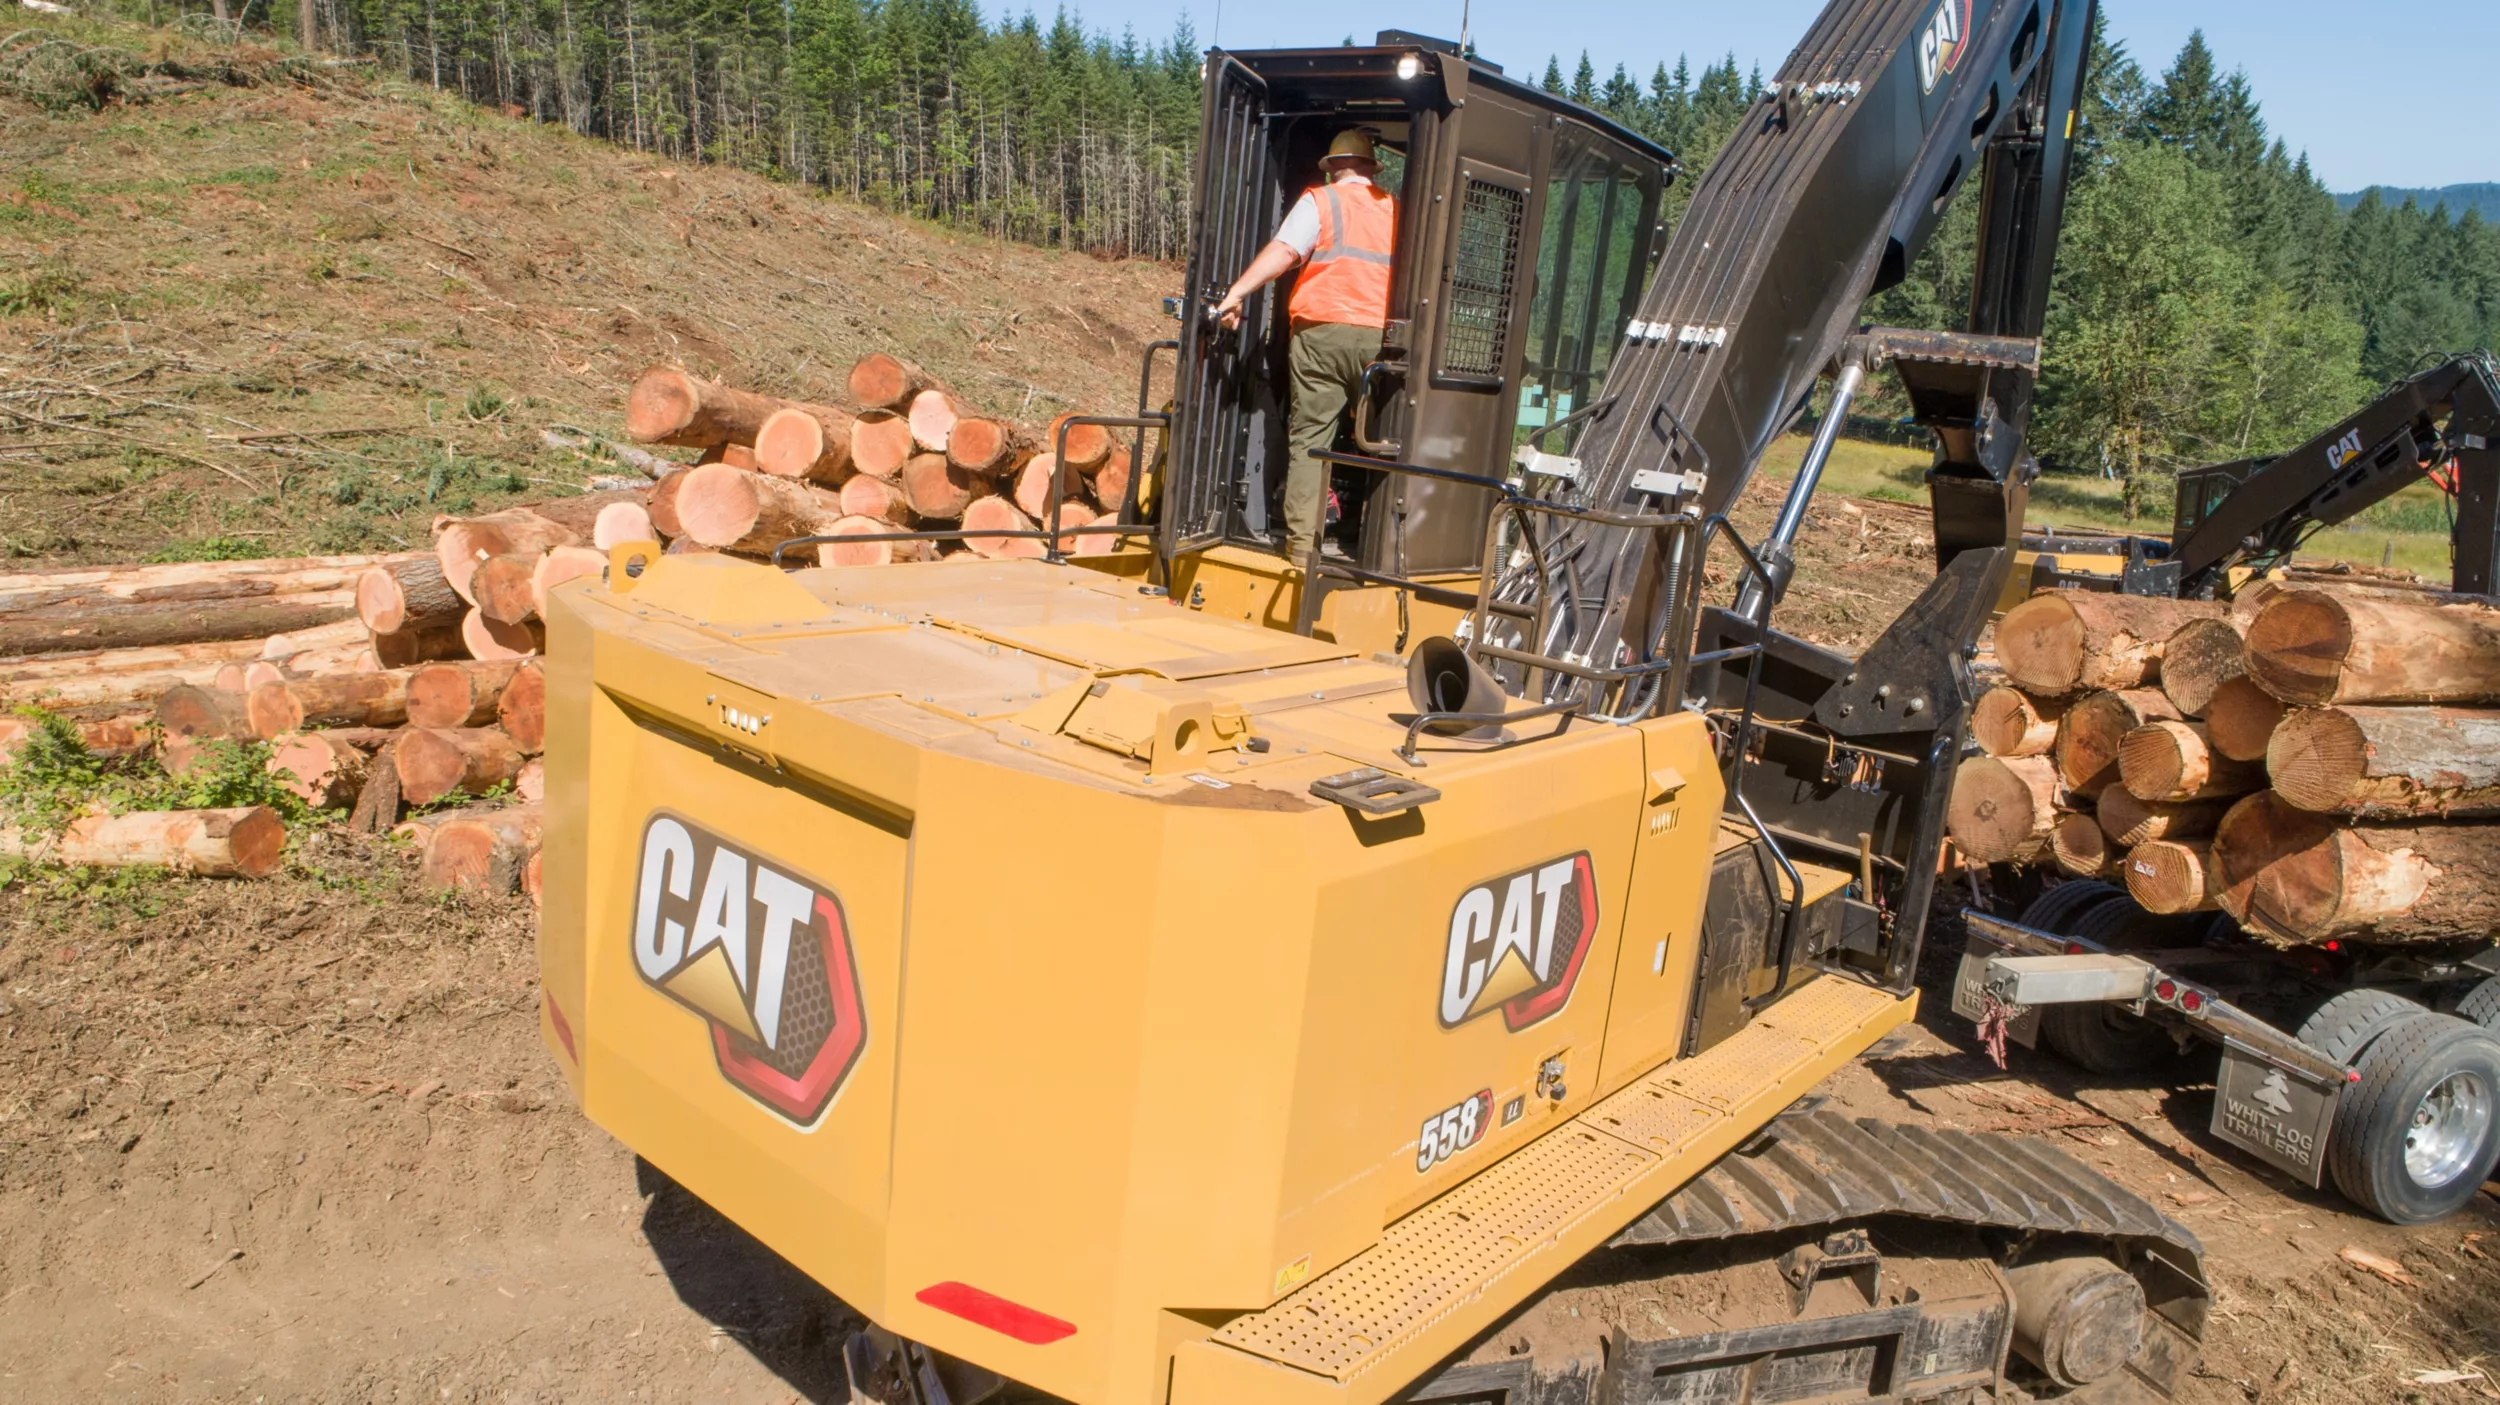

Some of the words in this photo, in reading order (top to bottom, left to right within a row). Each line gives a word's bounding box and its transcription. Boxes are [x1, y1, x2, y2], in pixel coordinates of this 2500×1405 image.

[2326, 427, 2363, 470] CAT
[634, 817, 815, 1051] CAT
[1441, 857, 1576, 1023] CAT
[1418, 1096, 1480, 1171] 558
[2226, 1113, 2310, 1166] TRAILERS
[2227, 1098, 2313, 1152] WHIT-LOG
